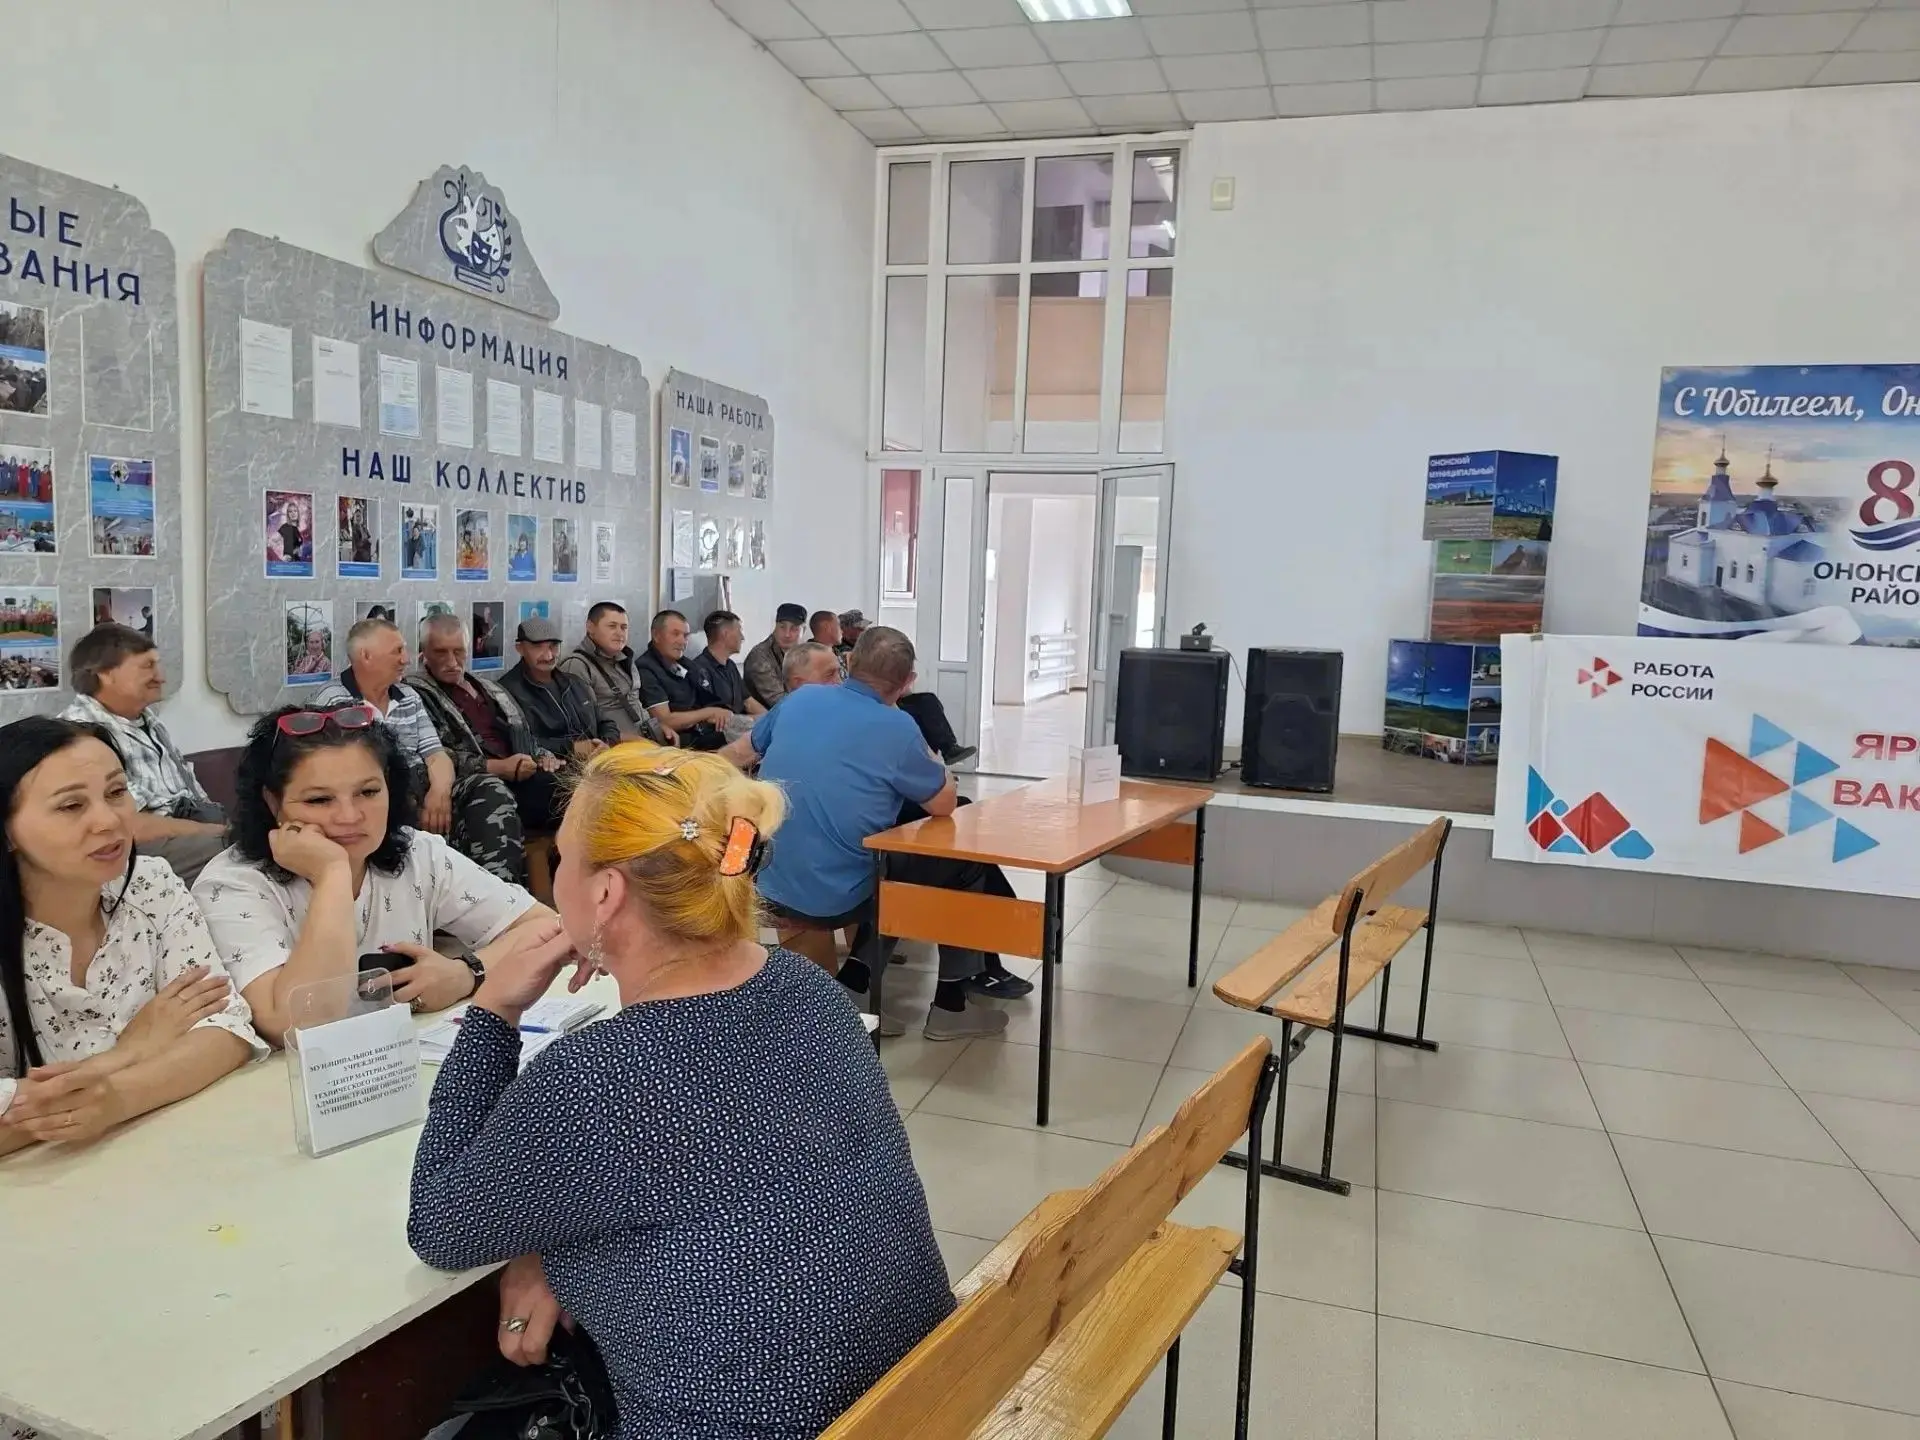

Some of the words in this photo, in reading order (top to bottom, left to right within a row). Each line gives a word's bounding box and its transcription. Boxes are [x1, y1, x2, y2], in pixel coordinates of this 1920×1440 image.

[370, 301, 569, 380] ИНФОРМАЦИЯ
[676, 390, 714, 418] НАША
[720, 403, 764, 431] РАБОТА
[1674, 386, 1697, 416] С
[1703, 386, 1864, 421] Юбилеем,
[342, 446, 412, 485] НАШ
[436, 460, 588, 505] КОЛЛЕКТИВ
[1859, 460, 1920, 527] 8
[1813, 560, 1920, 584] ОНОНС
[1850, 583, 1920, 606] РАЙО
[1633, 661, 1715, 679] РАБОТА
[1631, 683, 1714, 702] РОССИИ
[1851, 733, 1920, 761] ЯР
[1833, 779, 1920, 812] ВАК
[309, 1049, 373, 1073] МУНИЦИПАЛЬНОЕ
[343, 1054, 388, 1072] УЧРЕЖДЕНИЕ
[314, 1079, 371, 1101] ТЕХНИЧЕСКОГО
